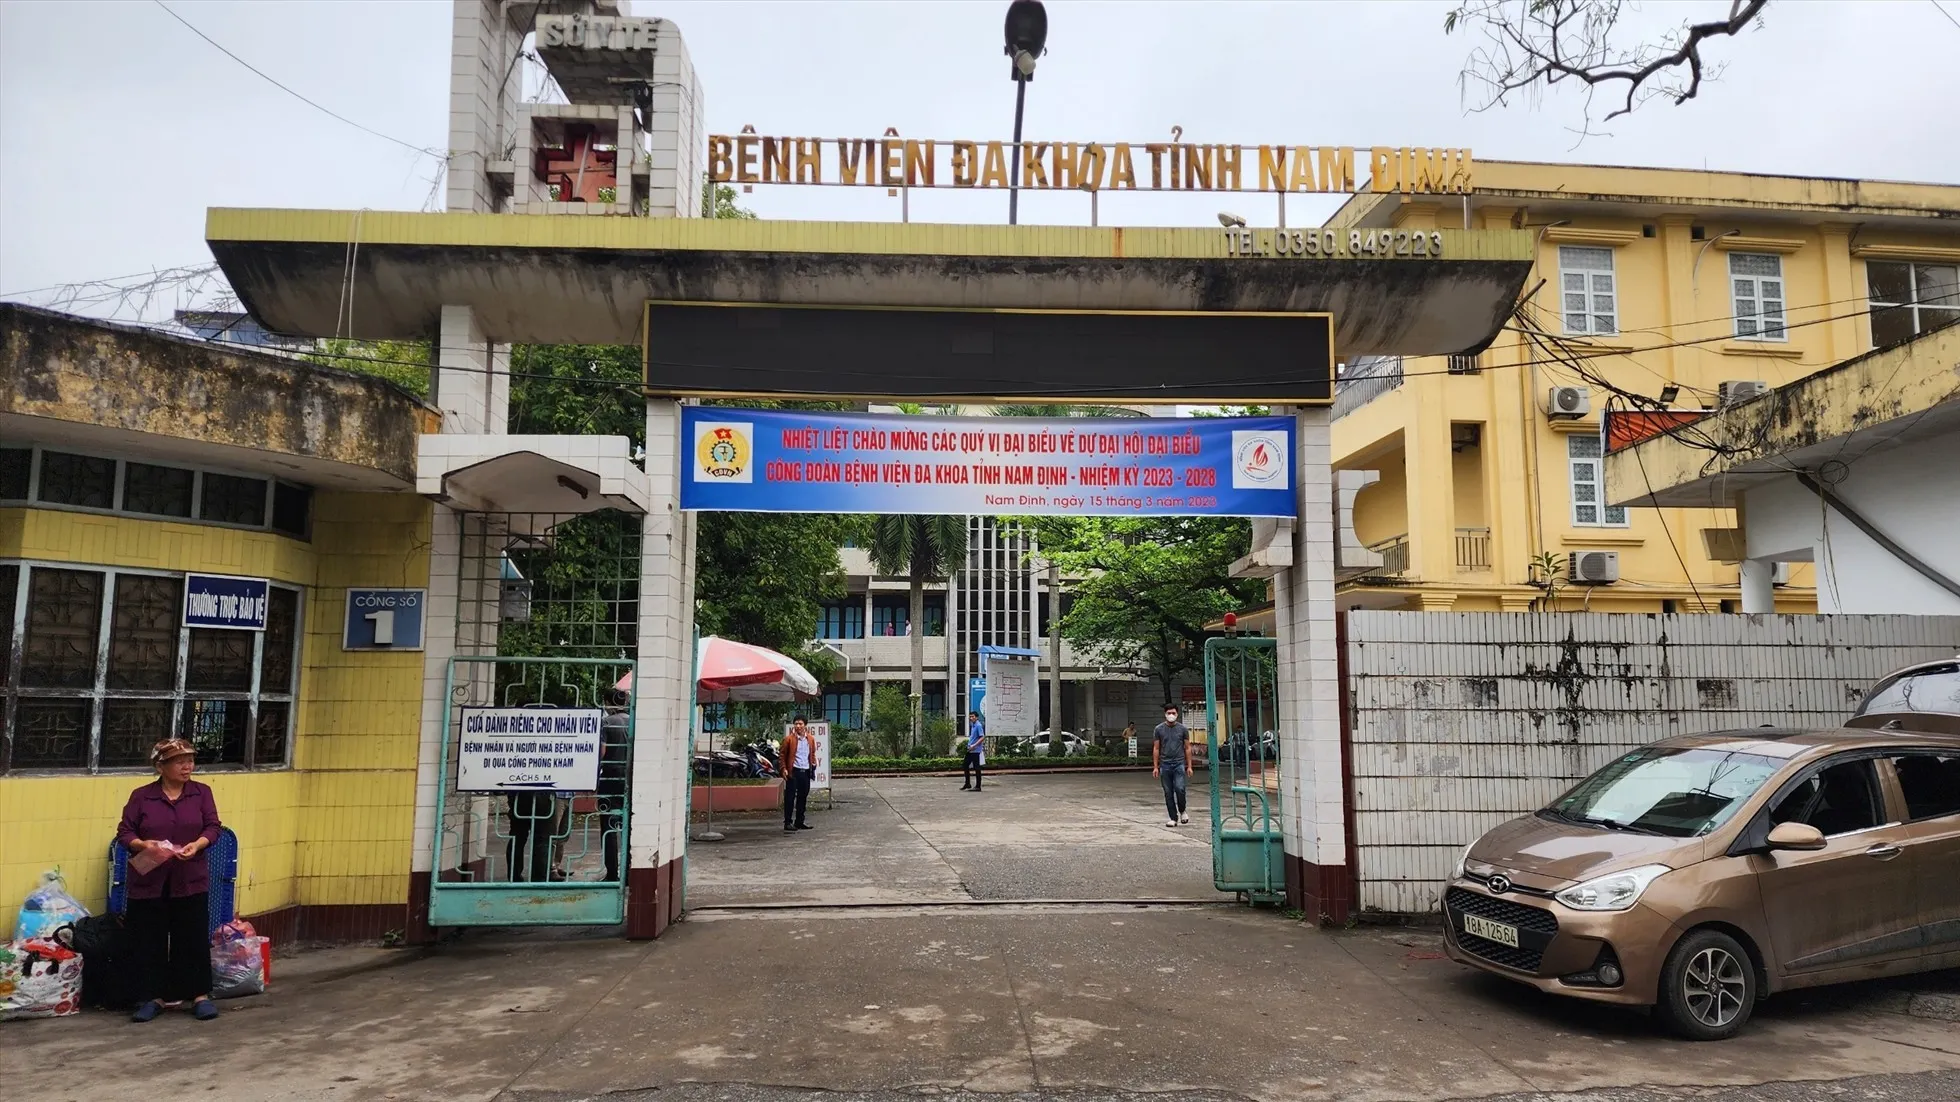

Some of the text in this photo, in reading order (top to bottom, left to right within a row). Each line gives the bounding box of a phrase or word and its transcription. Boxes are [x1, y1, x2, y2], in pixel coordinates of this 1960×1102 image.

[595, 22, 614, 49] Y
[622, 17, 662, 50] TẾ
[708, 124, 1473, 204] BỆNH VIỆN ĐA KHOA TỈNH NAM ĐỊNH
[1225, 227, 1443, 257] TEL: 0350.849223
[782, 426, 820, 454] NHIỆT
[823, 426, 849, 454] LIỆT
[852, 427, 886, 451] CHÀO
[890, 427, 928, 452] MỪNG
[932, 428, 957, 452] CÁC
[960, 429, 985, 453] QUÝ
[988, 433, 1000, 457] VỊ
[1003, 433, 1024, 457] ĐẠI
[1028, 427, 1057, 453] BIỂU
[1060, 427, 1075, 453] VỀ
[1078, 432, 1097, 458] DỰ
[1099, 434, 1120, 458] ĐẠI
[1123, 431, 1144, 458] HỘI
[1148, 435, 1169, 458] ĐẠI
[766, 458, 801, 482] CÔNG
[805, 459, 841, 482] ĐOÀN
[844, 459, 878, 487] BỆNH
[882, 460, 911, 487] VIỆN
[914, 463, 932, 484] ĐA
[935, 464, 969, 484] KHOA
[972, 458, 1001, 485] TỈNH
[1004, 465, 1034, 485] NAM
[1037, 466, 1067, 489] ĐỊNH
[1079, 463, 1120, 490] NHIỆM
[1124, 463, 1140, 486] KỲ
[1143, 468, 1173, 487] 2023
[1185, 468, 1216, 487] 2028
[985, 494, 1217, 509] Nam Định, ngày 15 tháng 3 năm 2023
[188, 588, 265, 624] THƯỜNG TRỰC BẢO VỆ
[355, 591, 417, 607] CỔNG SỐ
[364, 610, 395, 644] 1
[485, 713, 508, 733] DÀNH
[510, 713, 535, 733] RIÊNG
[536, 716, 553, 733] CHO
[554, 714, 578, 733] NHÂN
[579, 714, 598, 734] VIÊN
[483, 758, 491, 768] ĐI
[492, 757, 506, 769] QUA
[1466, 915, 1517, 946] 18A-125.64
